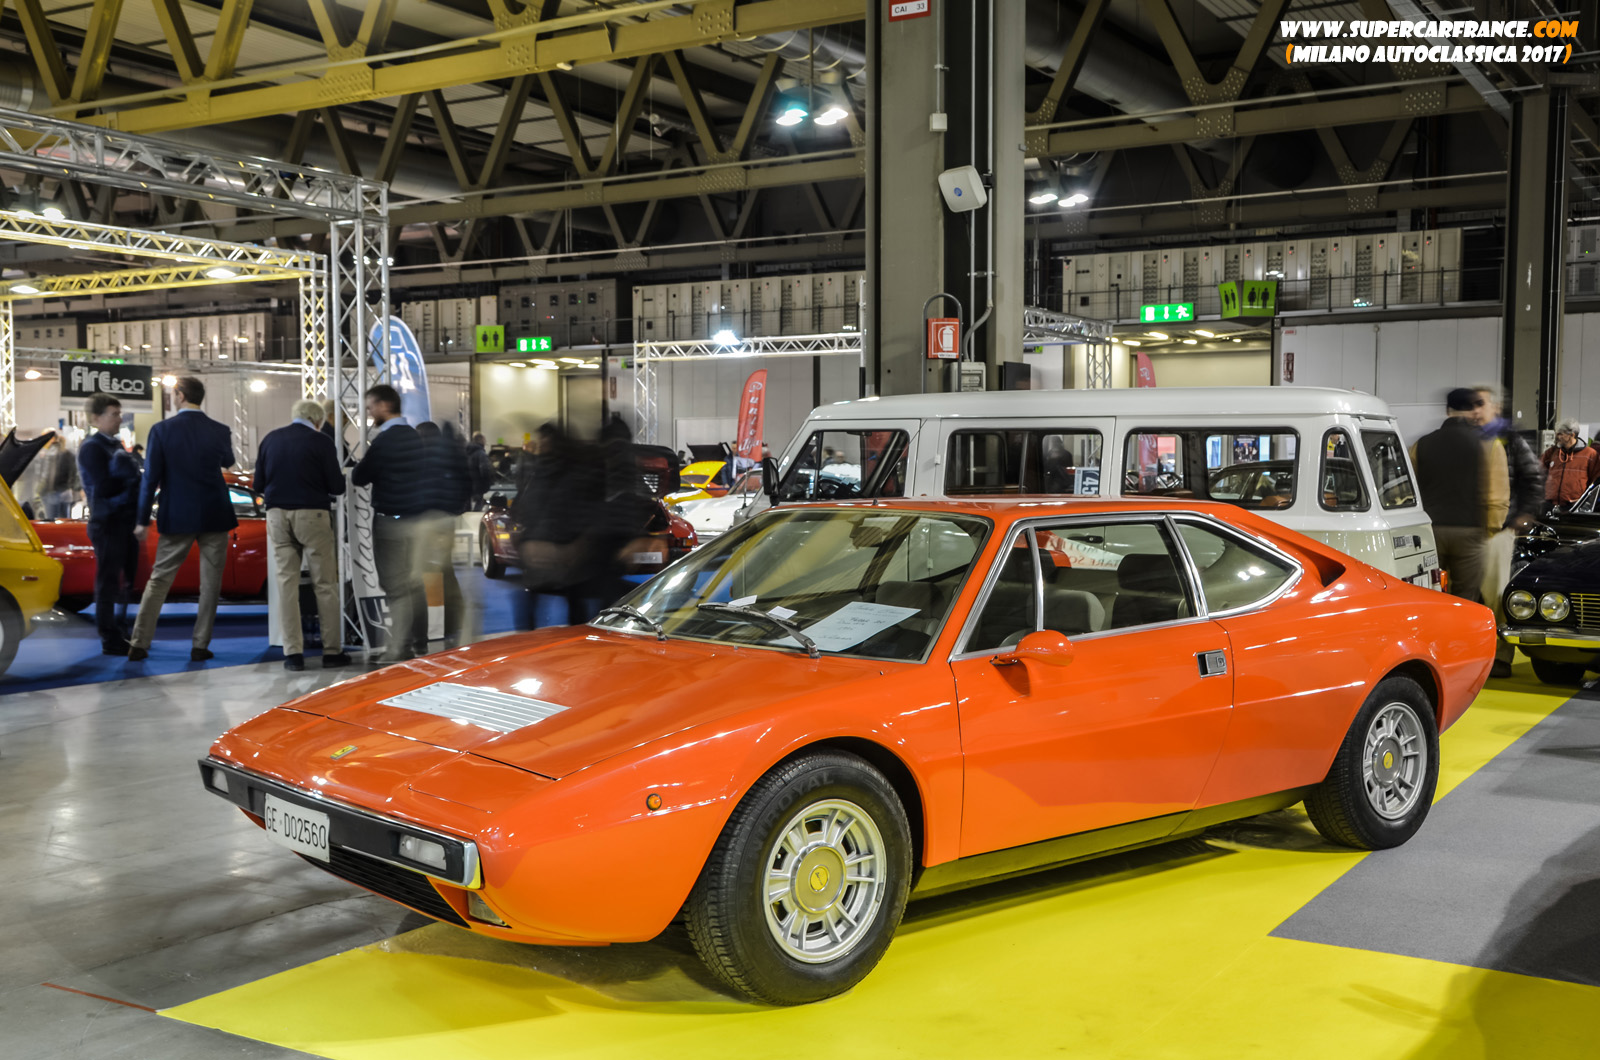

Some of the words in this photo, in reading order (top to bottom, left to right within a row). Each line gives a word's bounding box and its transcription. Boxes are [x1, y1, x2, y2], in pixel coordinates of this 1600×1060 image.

[894, 6, 908, 14] CAI
[916, 2, 925, 10] 33
[266, 806, 278, 833] GE
